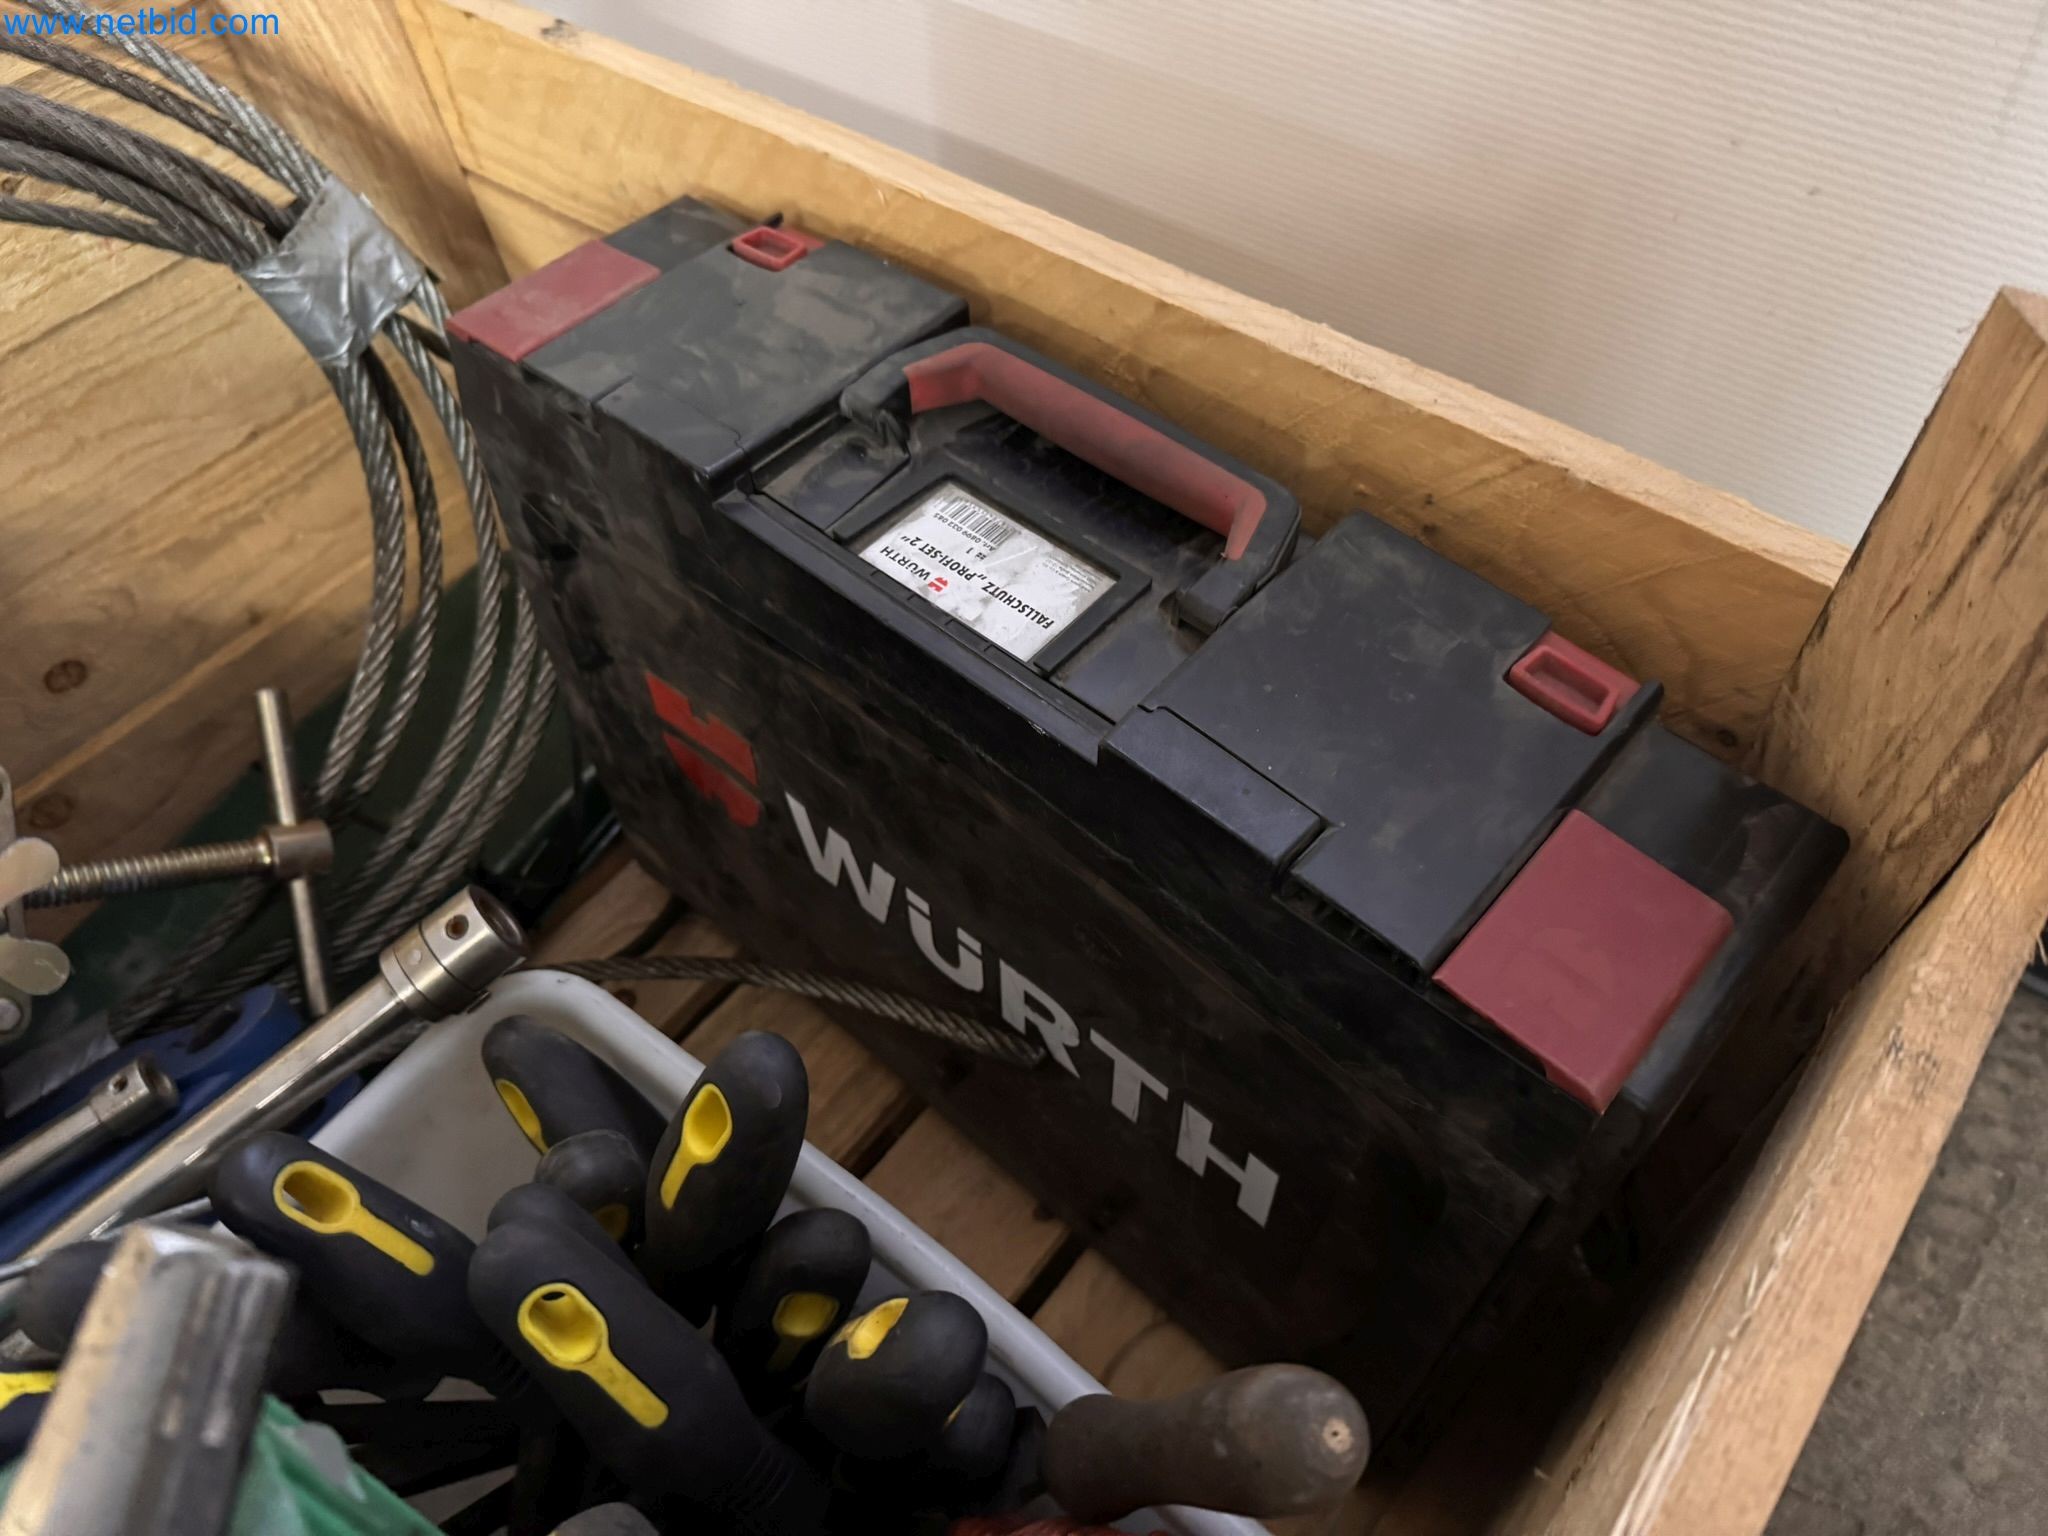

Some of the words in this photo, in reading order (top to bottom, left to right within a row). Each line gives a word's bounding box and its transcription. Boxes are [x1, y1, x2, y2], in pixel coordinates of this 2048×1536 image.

[880, 545, 931, 581] WÜRTH
[981, 581, 1055, 630] FALLSCHUTZ
[785, 790, 1280, 1229] WÜRTH
